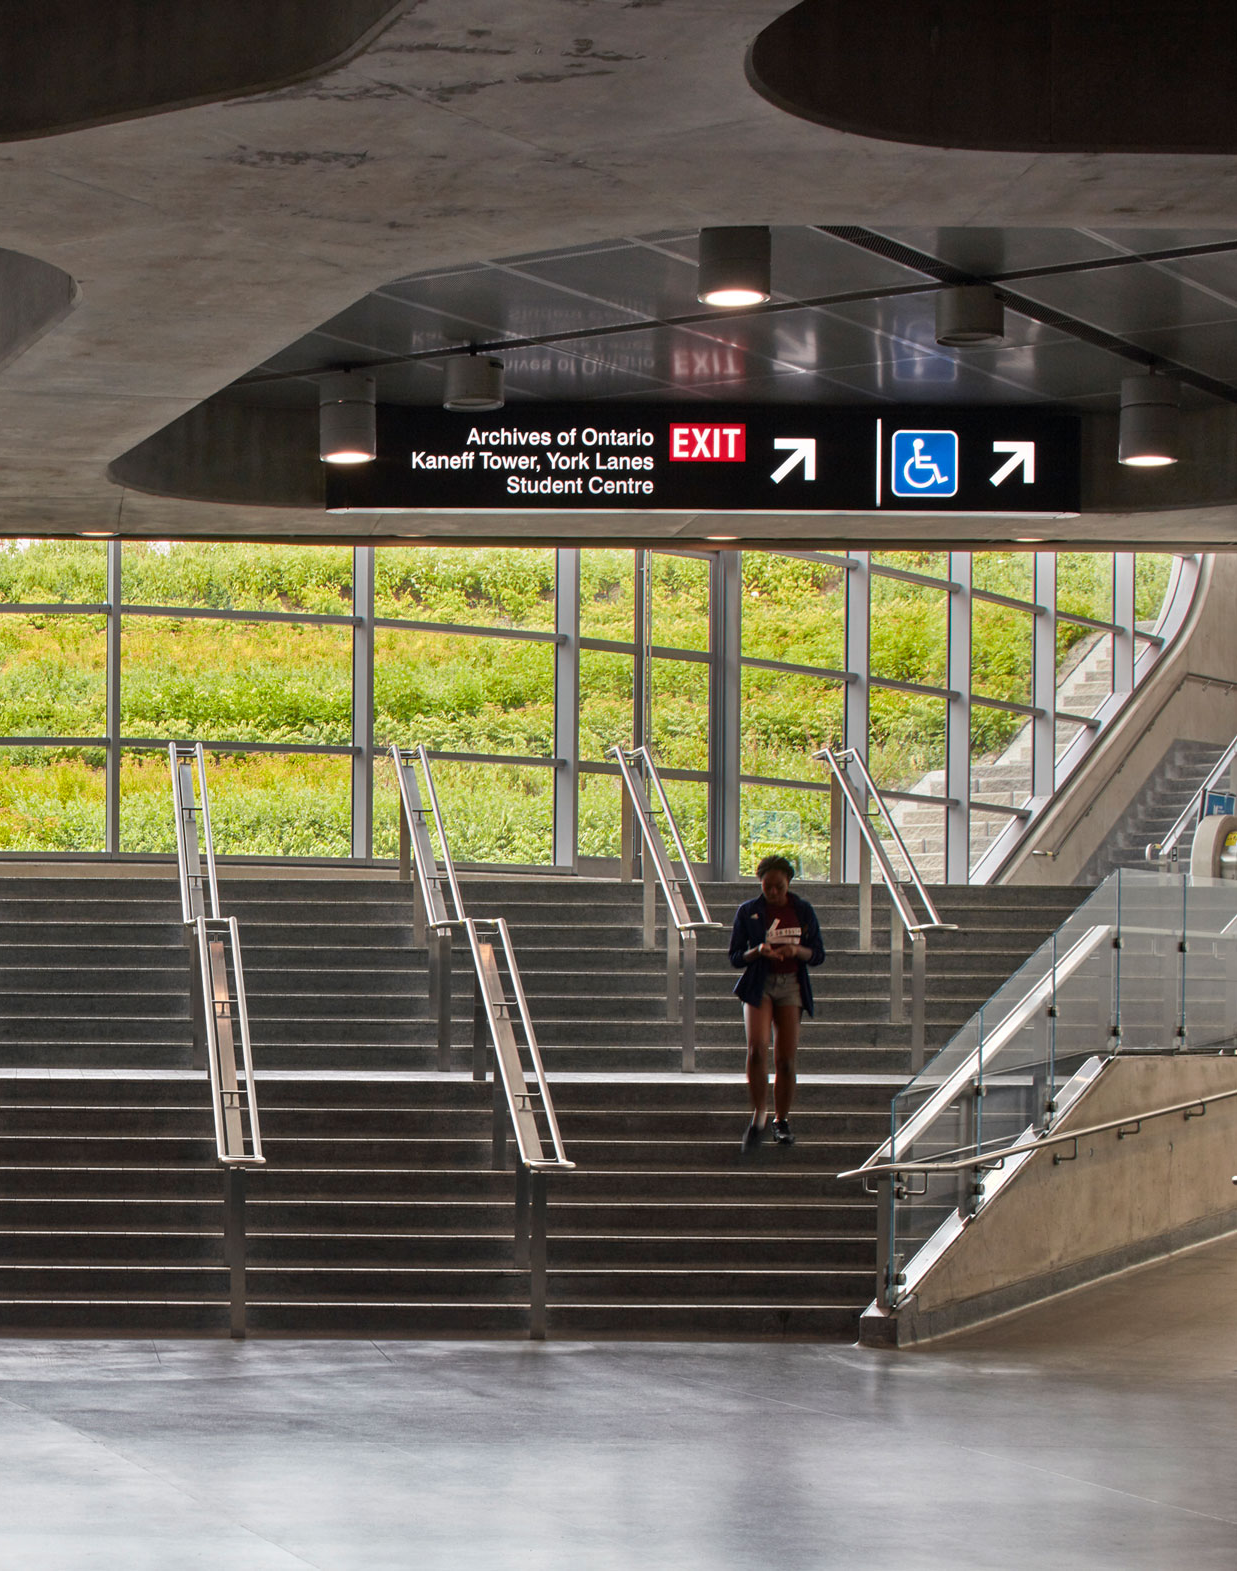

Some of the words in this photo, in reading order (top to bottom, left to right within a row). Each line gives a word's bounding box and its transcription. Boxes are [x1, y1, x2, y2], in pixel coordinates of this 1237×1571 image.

[467, 427, 551, 446] Archives
[557, 427, 576, 446] of
[582, 427, 653, 446] Ontario
[673, 428, 741, 458] EXIT
[412, 451, 474, 470] Kaneff
[479, 451, 540, 473] Tower,
[547, 451, 589, 470] York
[596, 451, 653, 470] Lanes
[507, 475, 582, 494] Student
[589, 475, 653, 494] Centre
